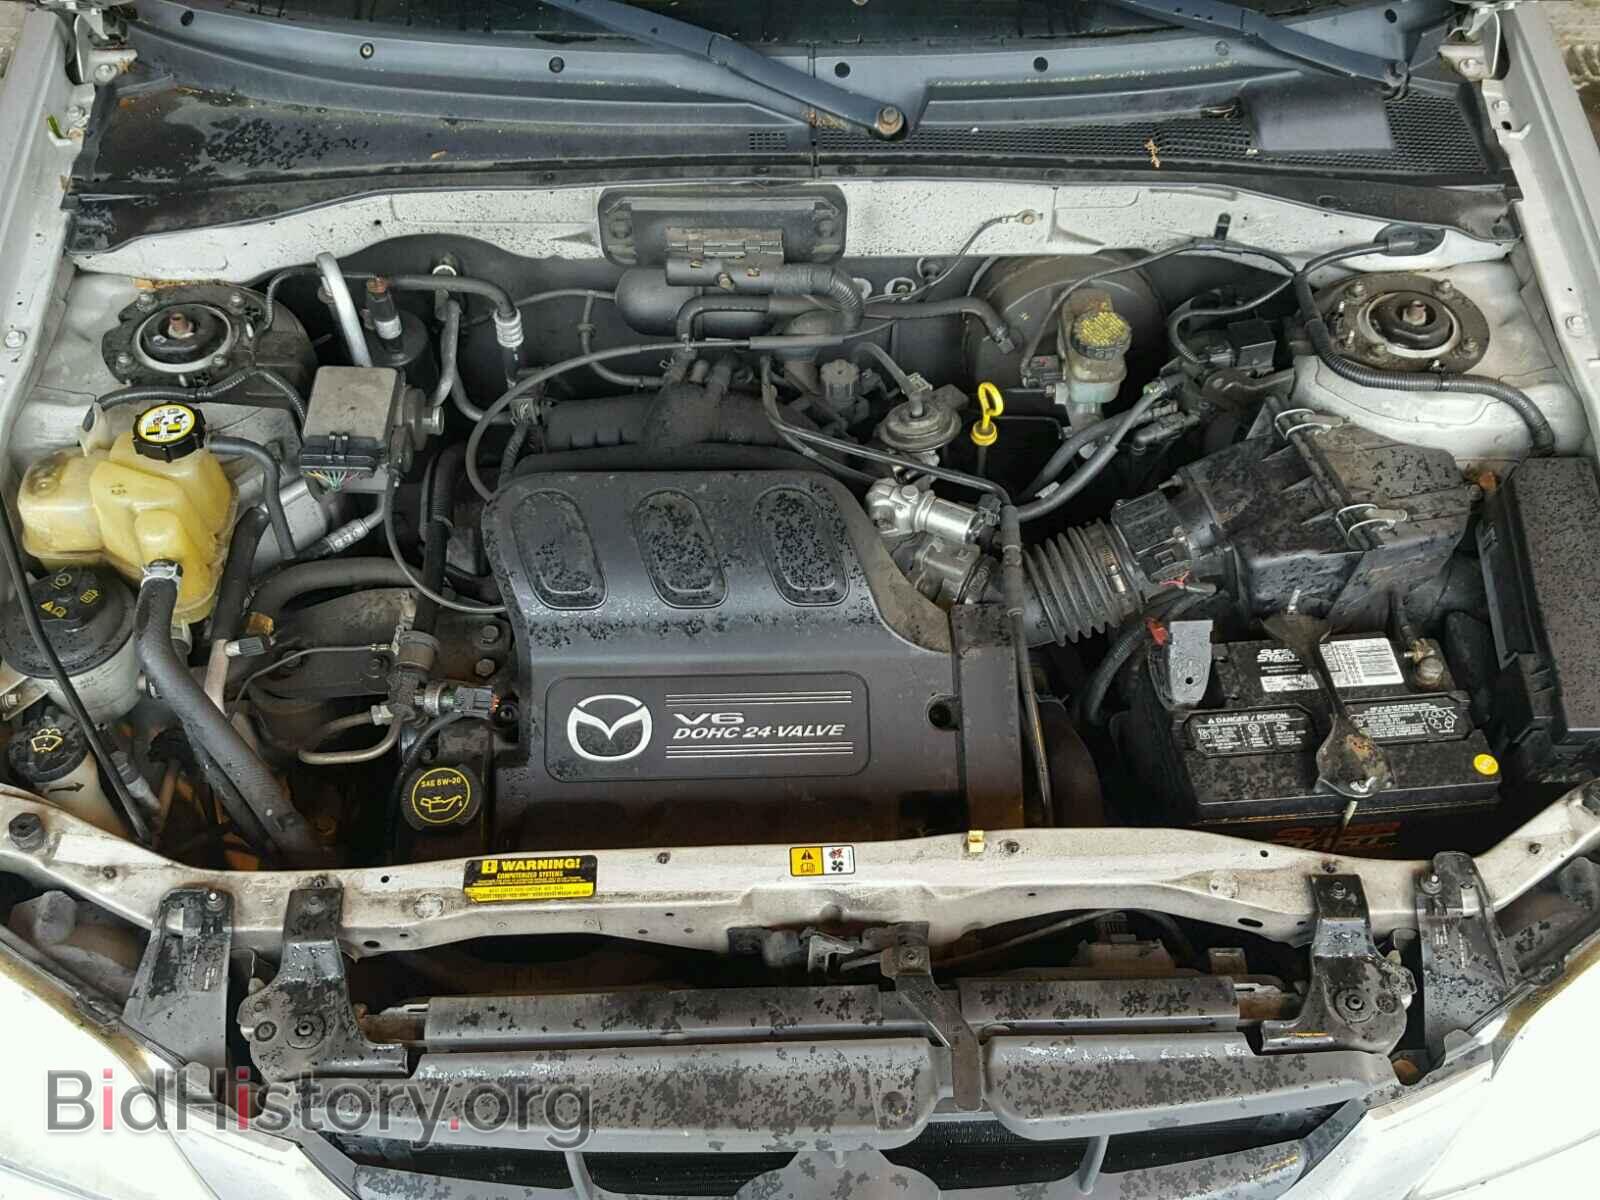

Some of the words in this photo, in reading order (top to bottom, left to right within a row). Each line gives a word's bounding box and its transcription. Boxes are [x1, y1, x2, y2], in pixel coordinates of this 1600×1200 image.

[673, 712, 745, 725] V6
[673, 727, 741, 739] DOHC
[421, 780, 436, 788] SAE
[502, 858, 581, 871] WARNING!
